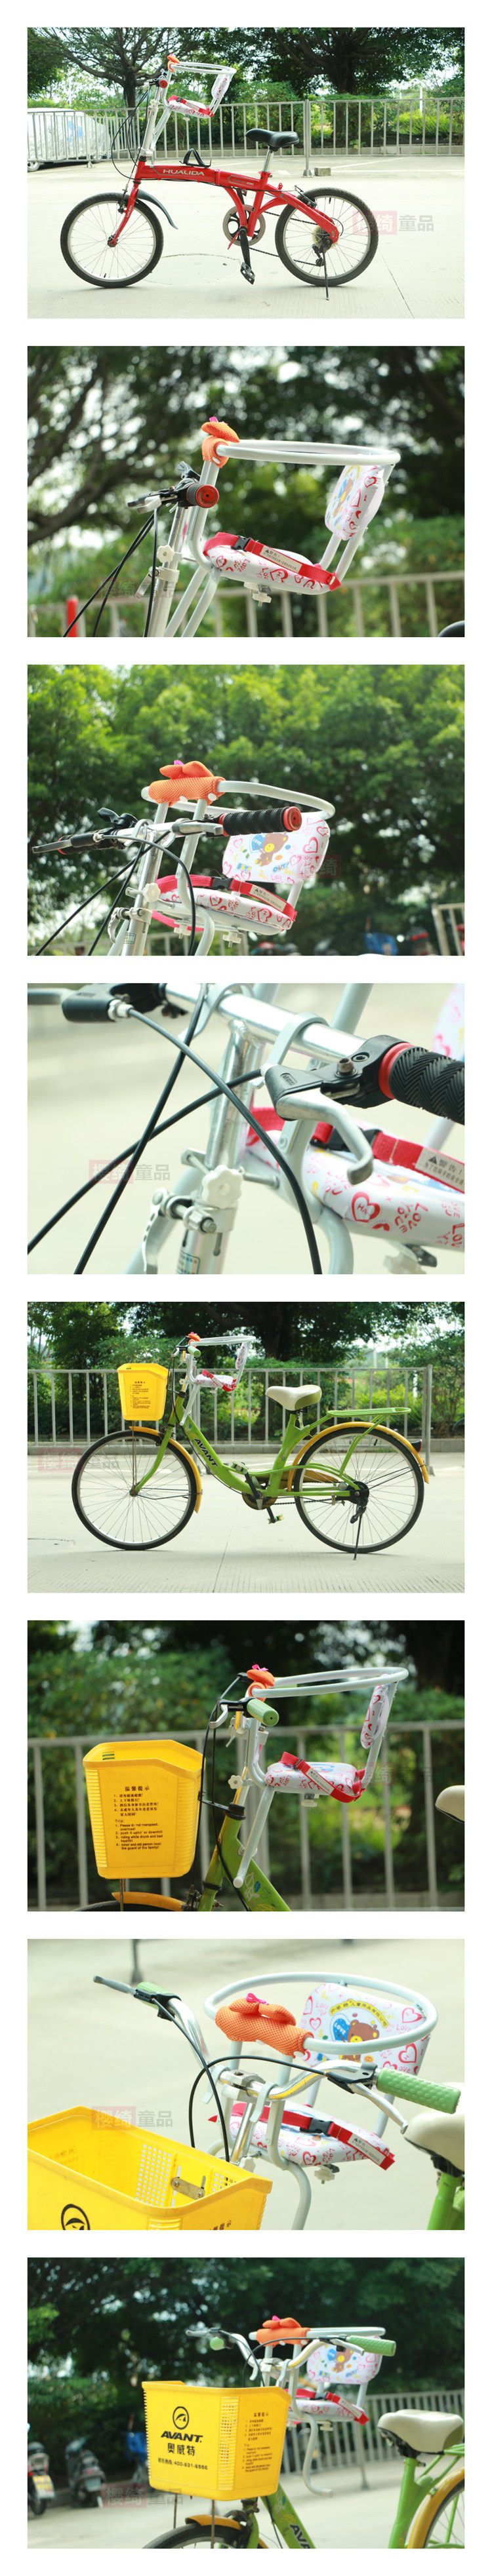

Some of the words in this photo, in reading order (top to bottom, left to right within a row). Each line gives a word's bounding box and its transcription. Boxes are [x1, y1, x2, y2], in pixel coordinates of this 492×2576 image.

[194, 1438, 219, 1468] AVANT
[334, 2022, 346, 2035] LOVE
[167, 2443, 195, 2457] 奥威特
